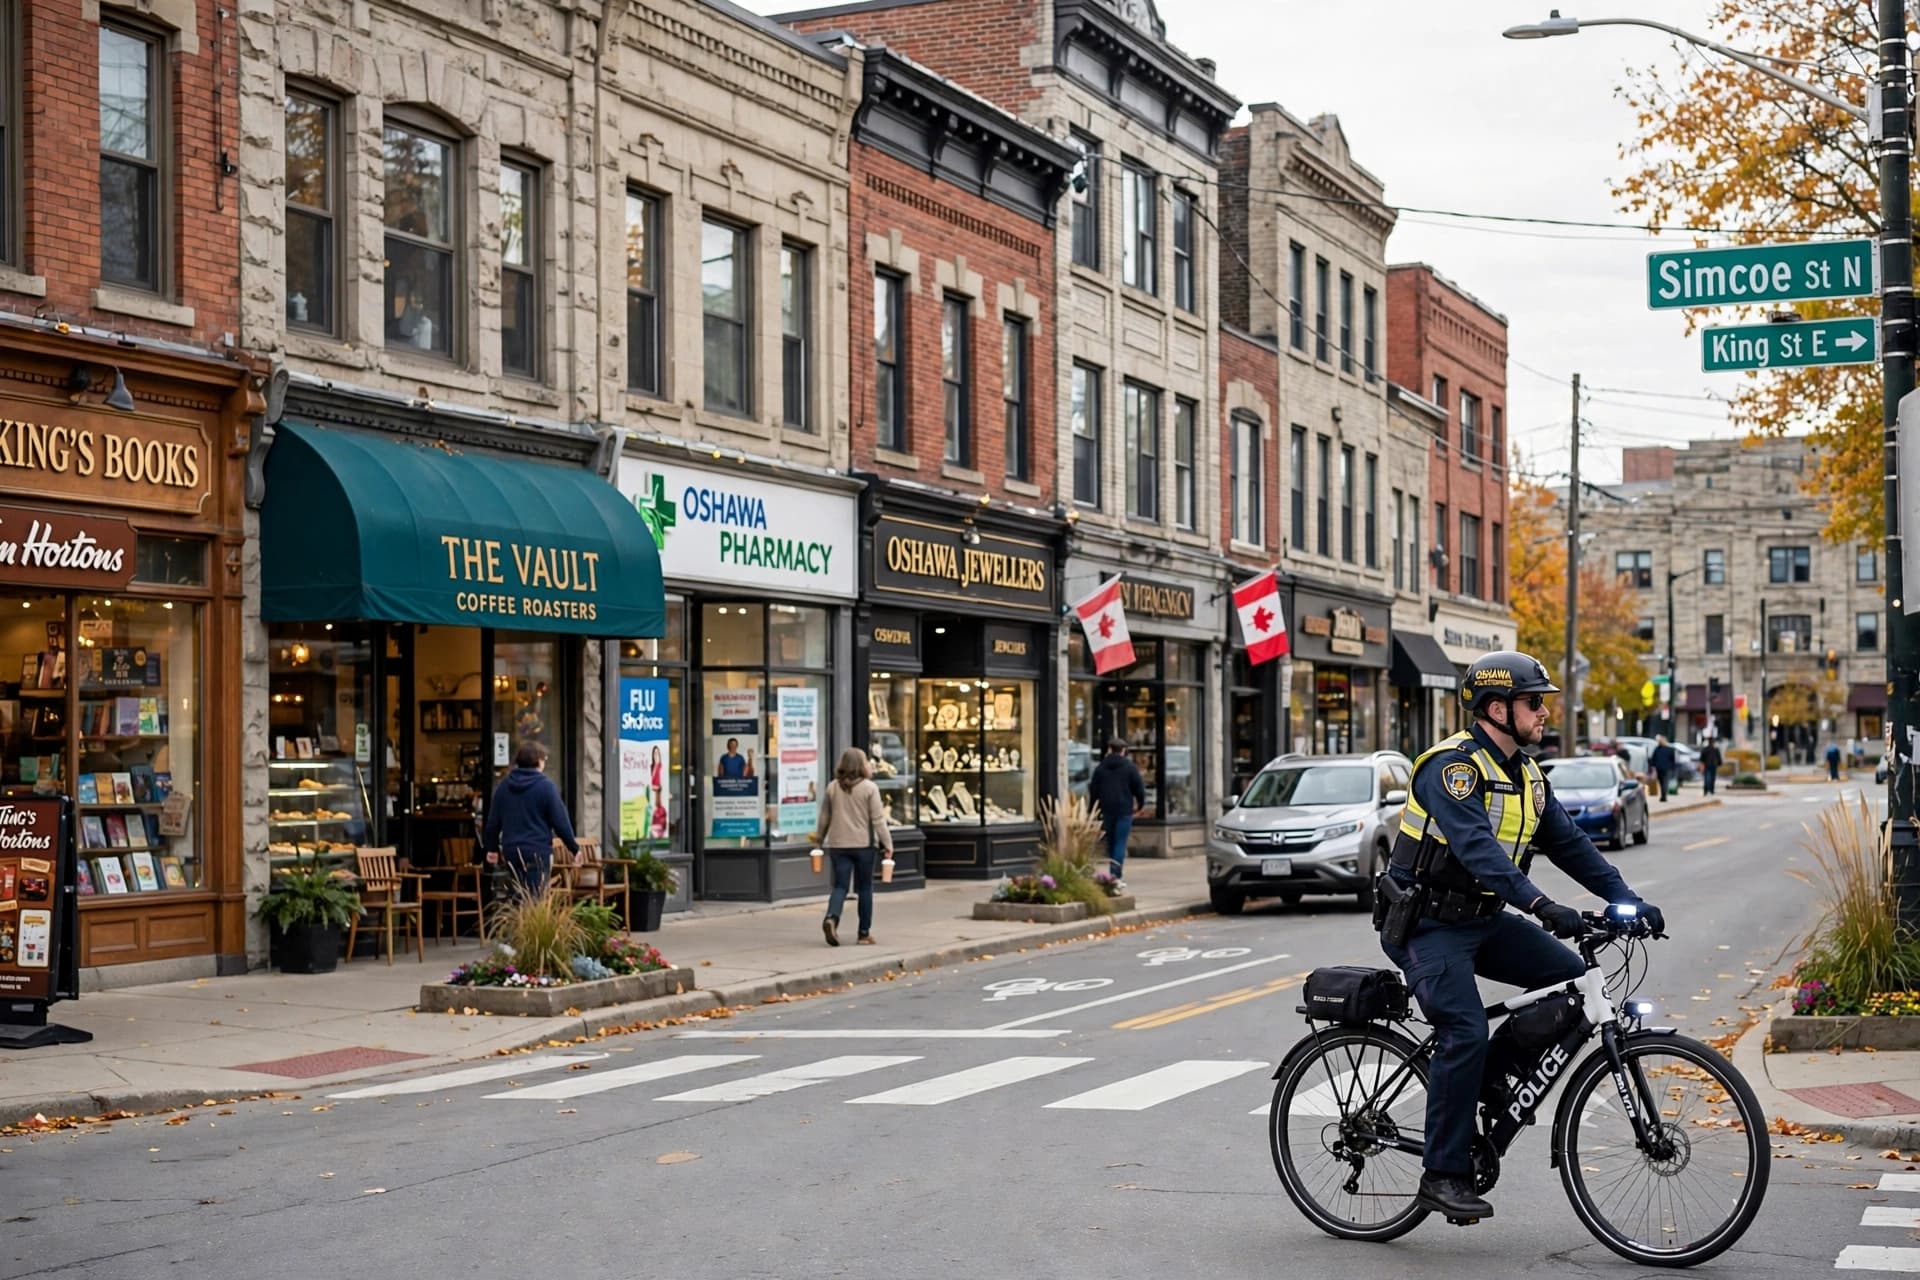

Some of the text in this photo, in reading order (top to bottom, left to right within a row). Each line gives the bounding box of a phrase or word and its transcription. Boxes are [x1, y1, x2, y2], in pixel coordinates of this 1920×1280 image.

[1658, 256, 1861, 300] Simcoe St N
[1712, 329, 1828, 367] King St E
[103, 433, 199, 489] BOOKS
[683, 486, 767, 531] OSHAWA
[20, 519, 124, 573] Hortons
[441, 535, 599, 592] THE VAULT
[720, 530, 832, 575] PHARMACY
[888, 535, 1045, 592] OSHAWA JEWELLERS
[456, 592, 597, 621] COFFEE ROASTERS
[630, 688, 656, 712] FLU
[1508, 1043, 1569, 1122] POLICE
